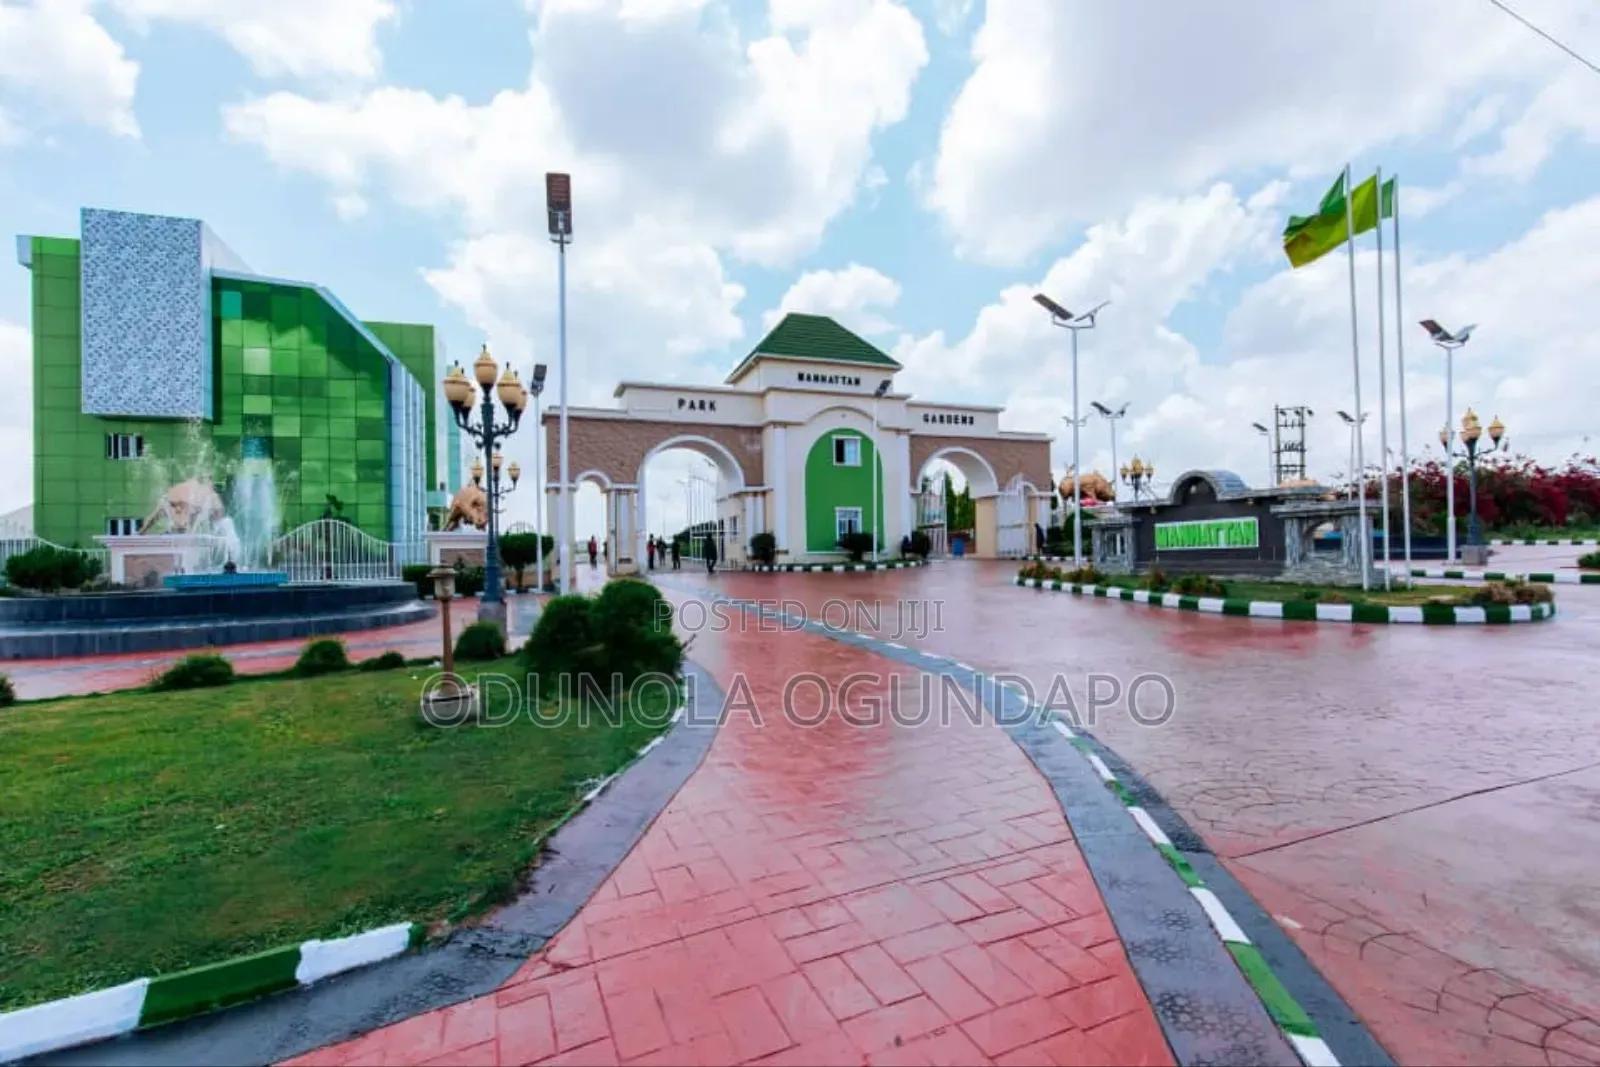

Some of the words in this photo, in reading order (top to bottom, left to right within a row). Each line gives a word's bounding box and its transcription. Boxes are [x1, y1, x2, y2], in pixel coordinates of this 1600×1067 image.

[797, 372, 861, 387] MANHATTAN
[677, 397, 717, 412] PARK
[922, 413, 975, 426] GARDENS
